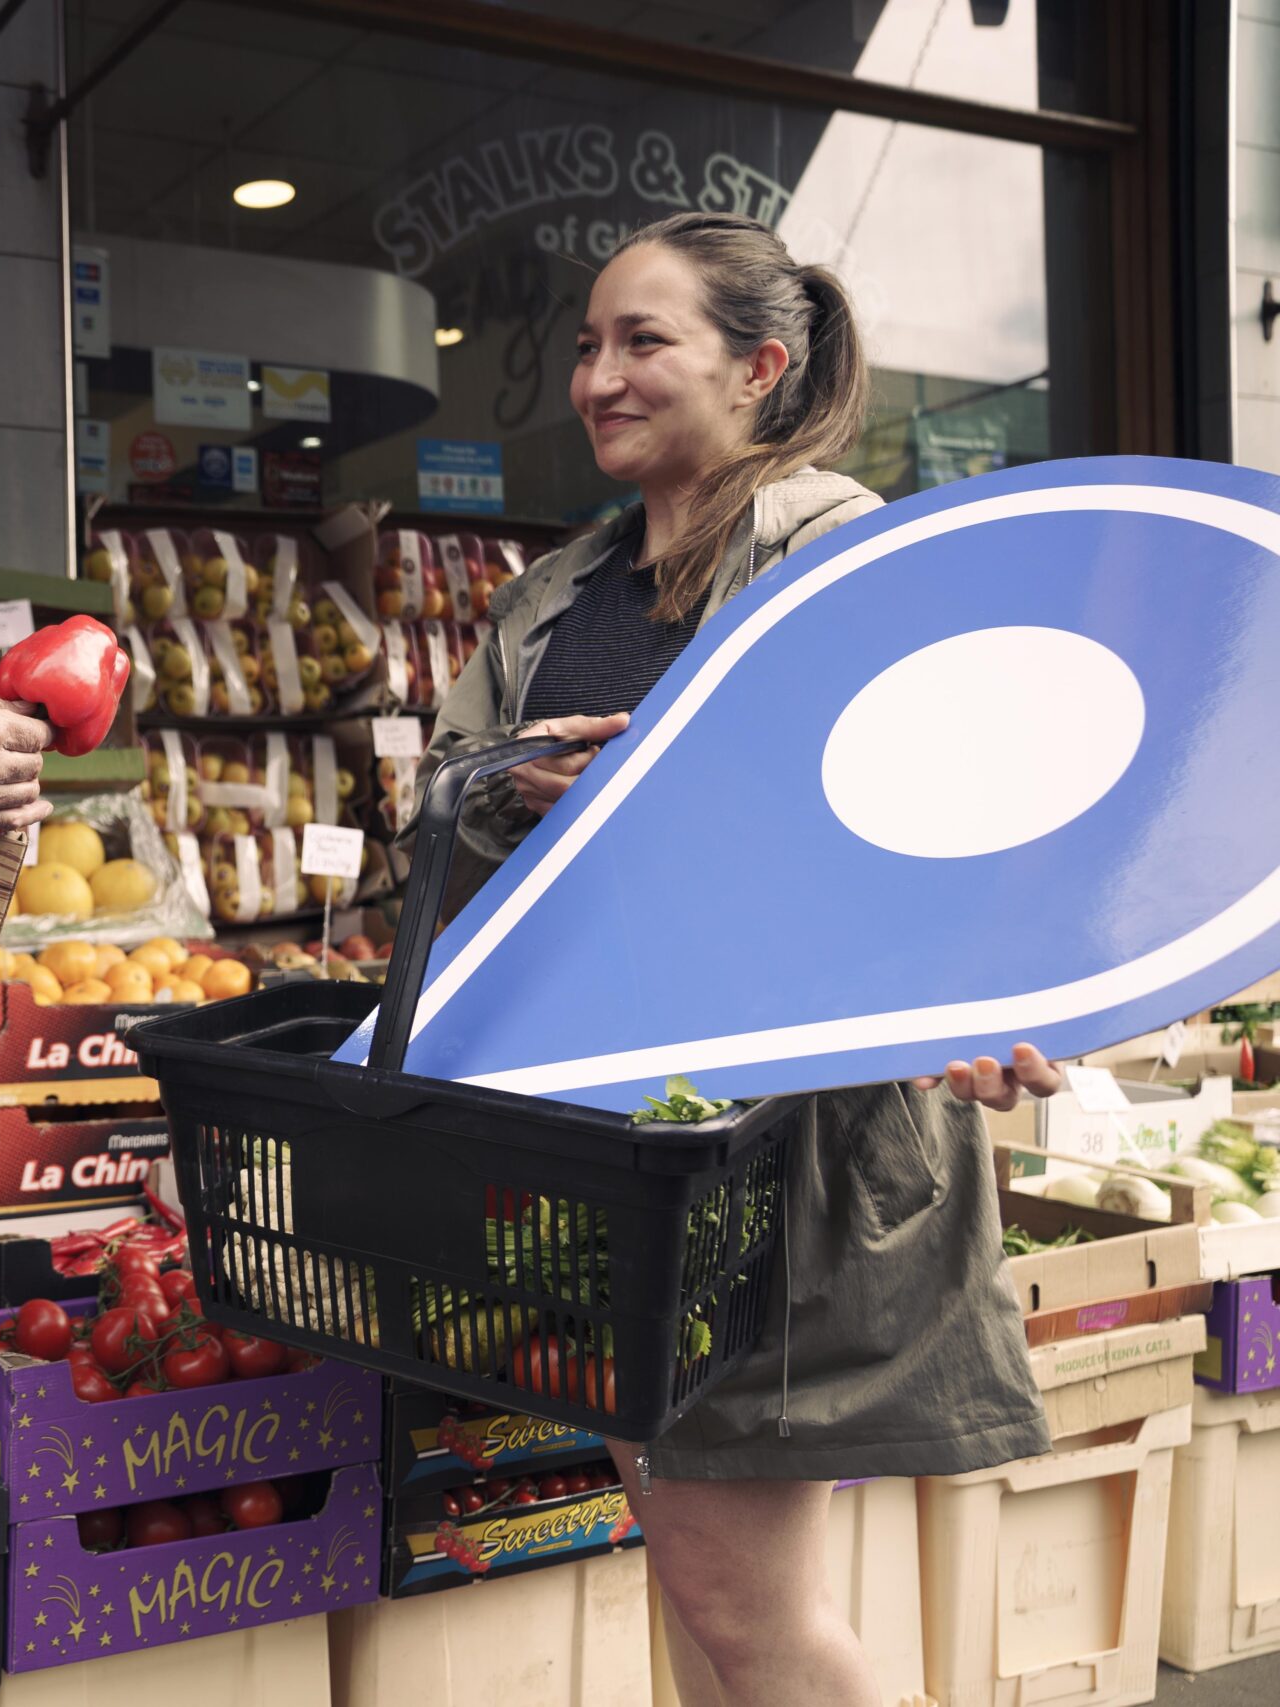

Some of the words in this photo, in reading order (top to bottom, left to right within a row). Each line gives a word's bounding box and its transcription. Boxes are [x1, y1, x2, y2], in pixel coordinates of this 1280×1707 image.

[373, 122, 620, 279] STALKS
[629, 129, 693, 208] &
[534, 213, 578, 254] of
[26, 1037, 70, 1069] La
[1081, 1131, 1103, 1154] 38
[20, 1159, 65, 1191] La
[1111, 1345, 1140, 1362] KENYA
[123, 1404, 281, 1492] MAGIC
[478, 1492, 624, 1561] Sweety's
[129, 1551, 285, 1638] MAGIC
